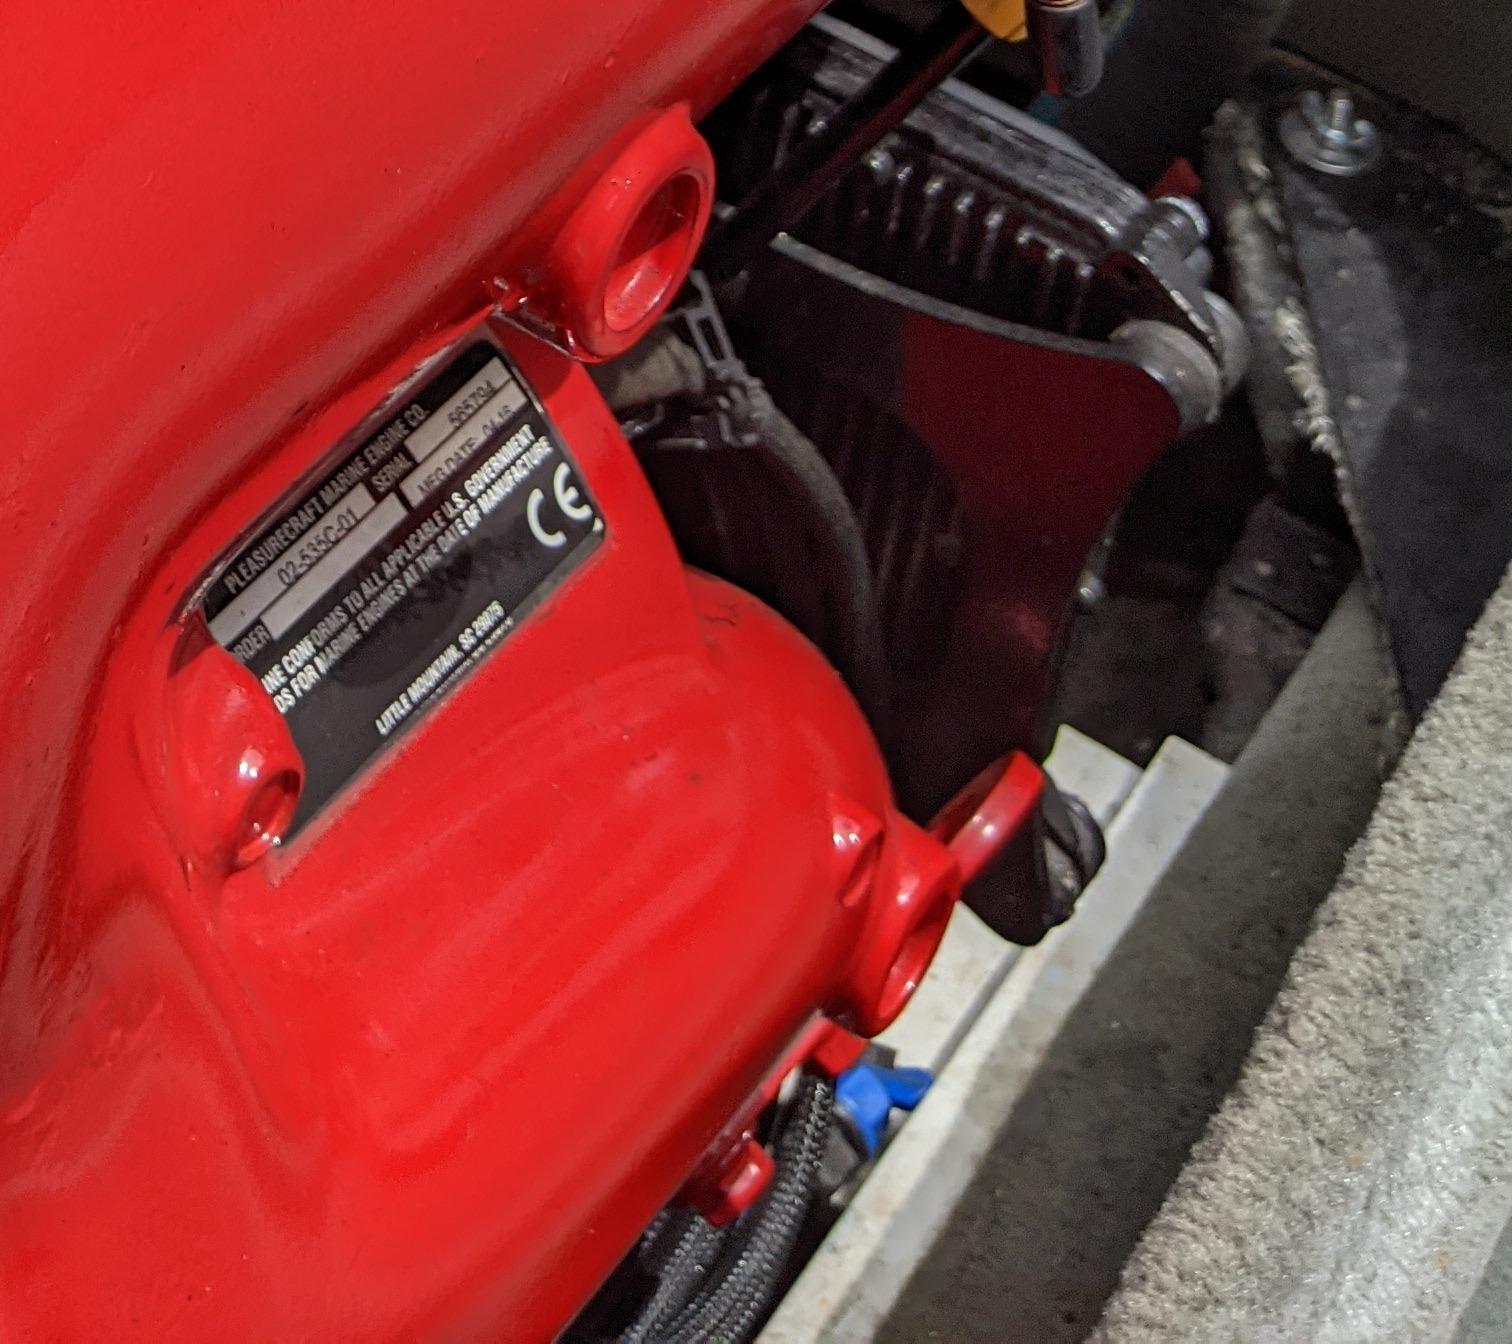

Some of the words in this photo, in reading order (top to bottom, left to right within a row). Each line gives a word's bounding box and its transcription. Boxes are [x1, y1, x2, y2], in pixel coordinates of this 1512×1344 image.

[222, 496, 324, 595] PLEASURECRAFT
[317, 454, 370, 505] MARINE
[361, 417, 409, 465] ENGINE
[279, 603, 350, 676] CONFORMS
[342, 589, 366, 613] TO
[357, 570, 387, 599] ALL
[377, 508, 448, 578] APPLICABLE
[461, 422, 538, 499] GOVERNMENT
[370, 449, 413, 493] SERIAL
[287, 662, 321, 699] FOR
[312, 621, 364, 674] MARINE
[355, 577, 408, 632] ENGINES
[399, 563, 424, 589] AT
[414, 542, 443, 574] THE
[434, 516, 471, 554] DATE
[459, 503, 486, 529] OF
[474, 434, 555, 515] MANUFACTURE
[372, 692, 415, 737] LITTLE
